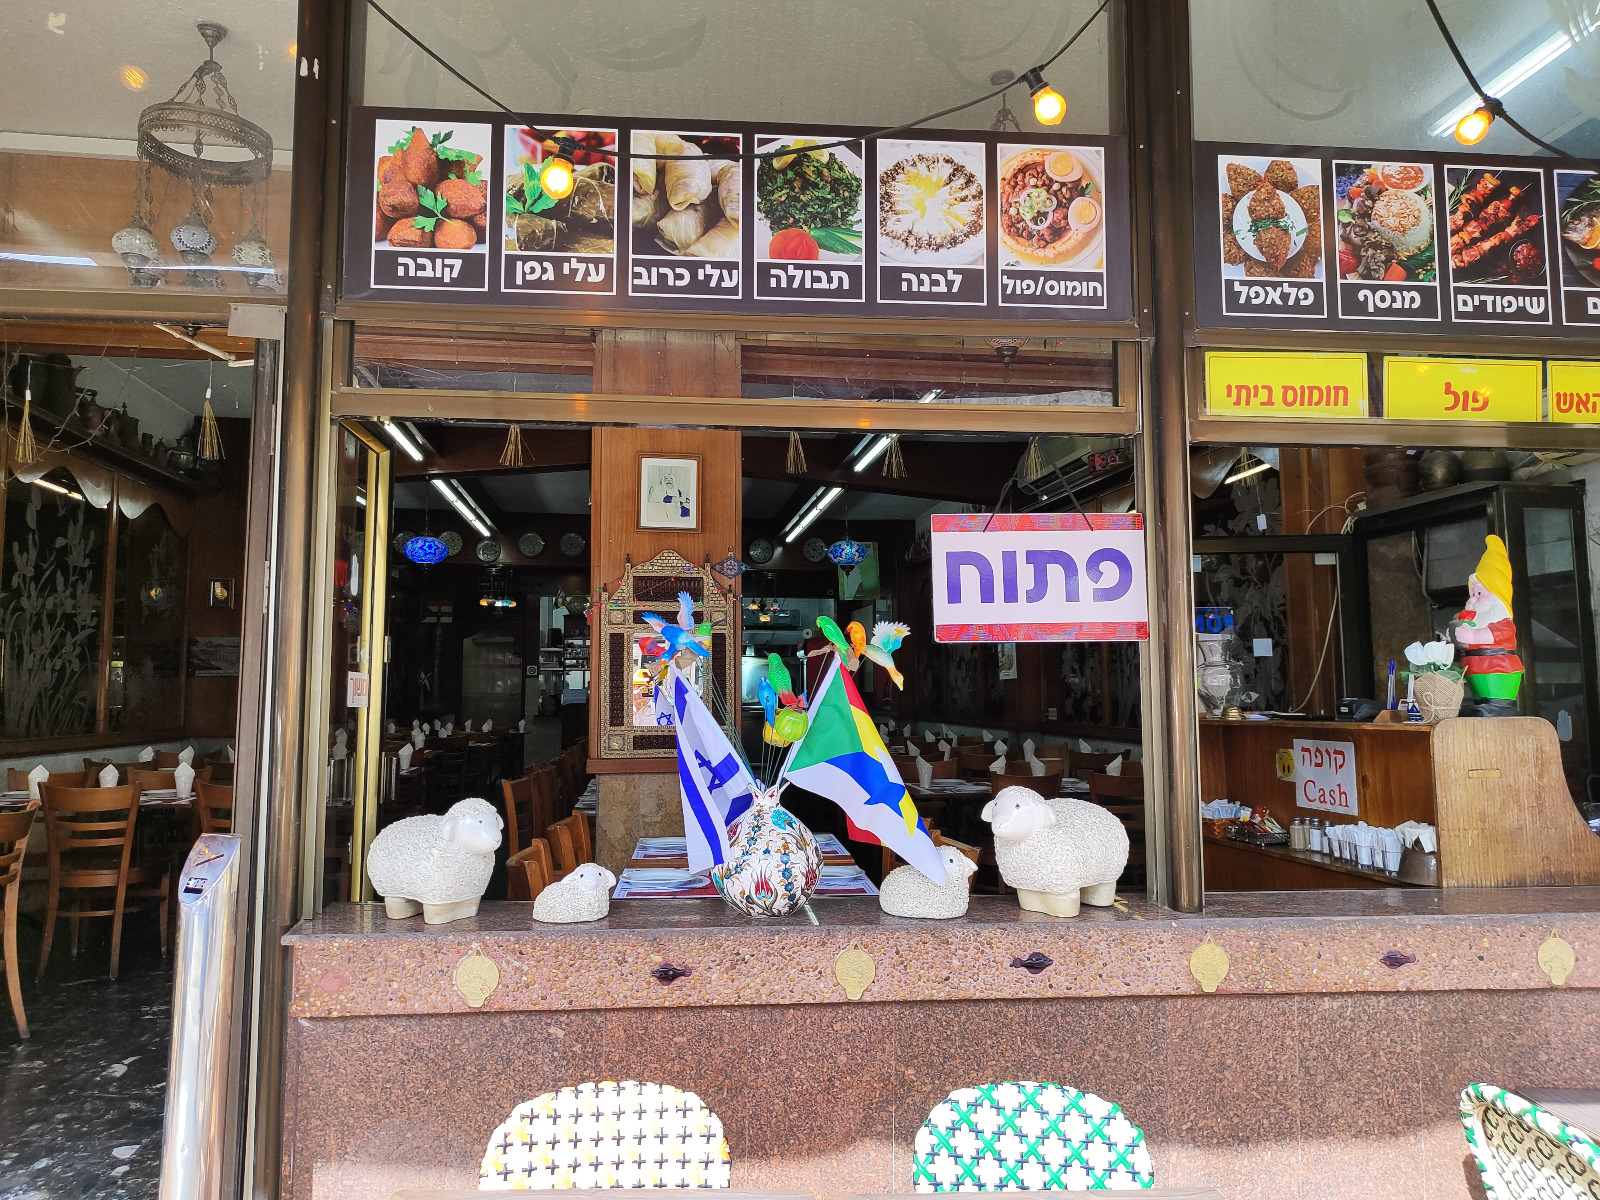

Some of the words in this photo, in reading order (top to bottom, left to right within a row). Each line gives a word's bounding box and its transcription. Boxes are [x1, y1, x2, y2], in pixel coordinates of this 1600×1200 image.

[398, 256, 462, 282] קובה
[515, 260, 555, 285] גפן
[562, 258, 606, 282] עלי
[633, 266, 691, 287] כרוב
[697, 265, 738, 288] עלי
[770, 265, 850, 290] תבולה
[901, 269, 963, 293] לבנה
[1002, 275, 1103, 297] חומוס/פול
[1233, 281, 1315, 306] פלאפל
[1357, 289, 1421, 312] מנסף
[1456, 294, 1546, 315] שיפודים
[1225, 383, 1275, 407] ביתי
[1281, 384, 1349, 408] חומוס
[1443, 381, 1490, 412] פול
[945, 547, 1133, 605] פתוח
[1300, 745, 1346, 775] קופה
[1303, 779, 1350, 808] Cash
